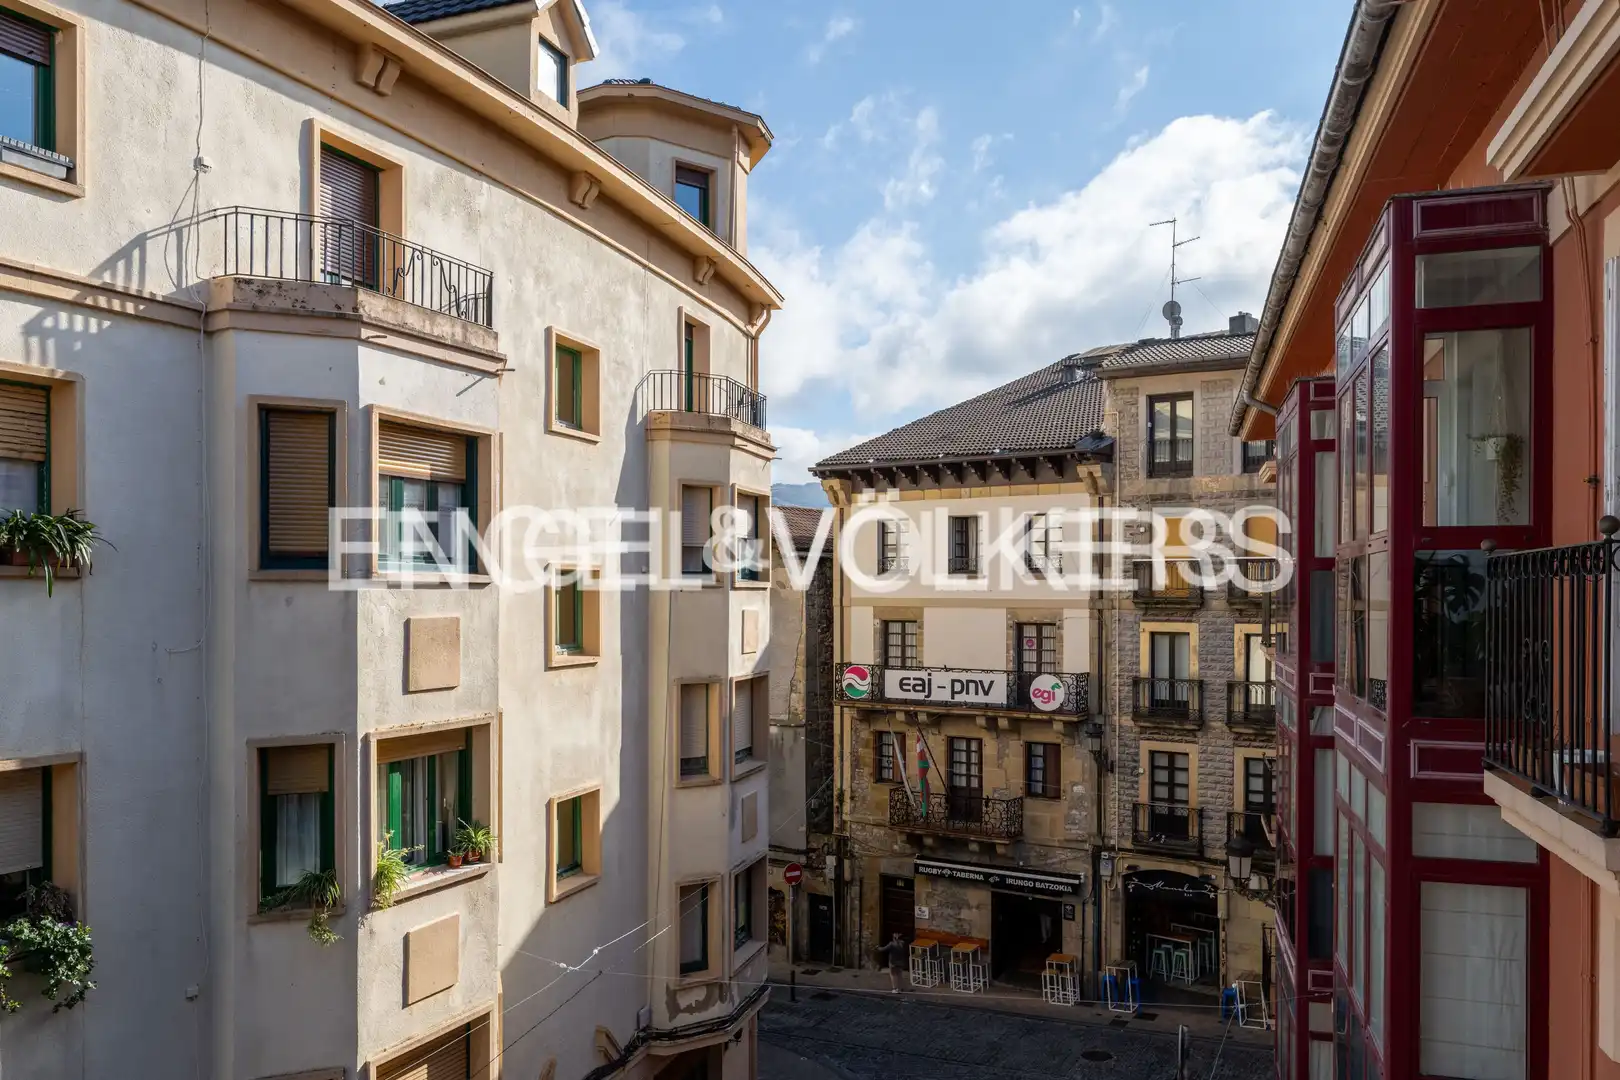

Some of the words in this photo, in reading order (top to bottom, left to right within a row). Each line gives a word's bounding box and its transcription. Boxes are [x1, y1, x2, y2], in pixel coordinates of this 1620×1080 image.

[899, 672, 932, 699] eaj
[951, 678, 995, 700] pnv
[1031, 686, 1057, 704] egi
[918, 865, 942, 875] RUGBY
[952, 870, 985, 881] TABERNA
[1005, 877, 1034, 888] IRUNGO
[1035, 881, 1073, 893] BATZOKIA
